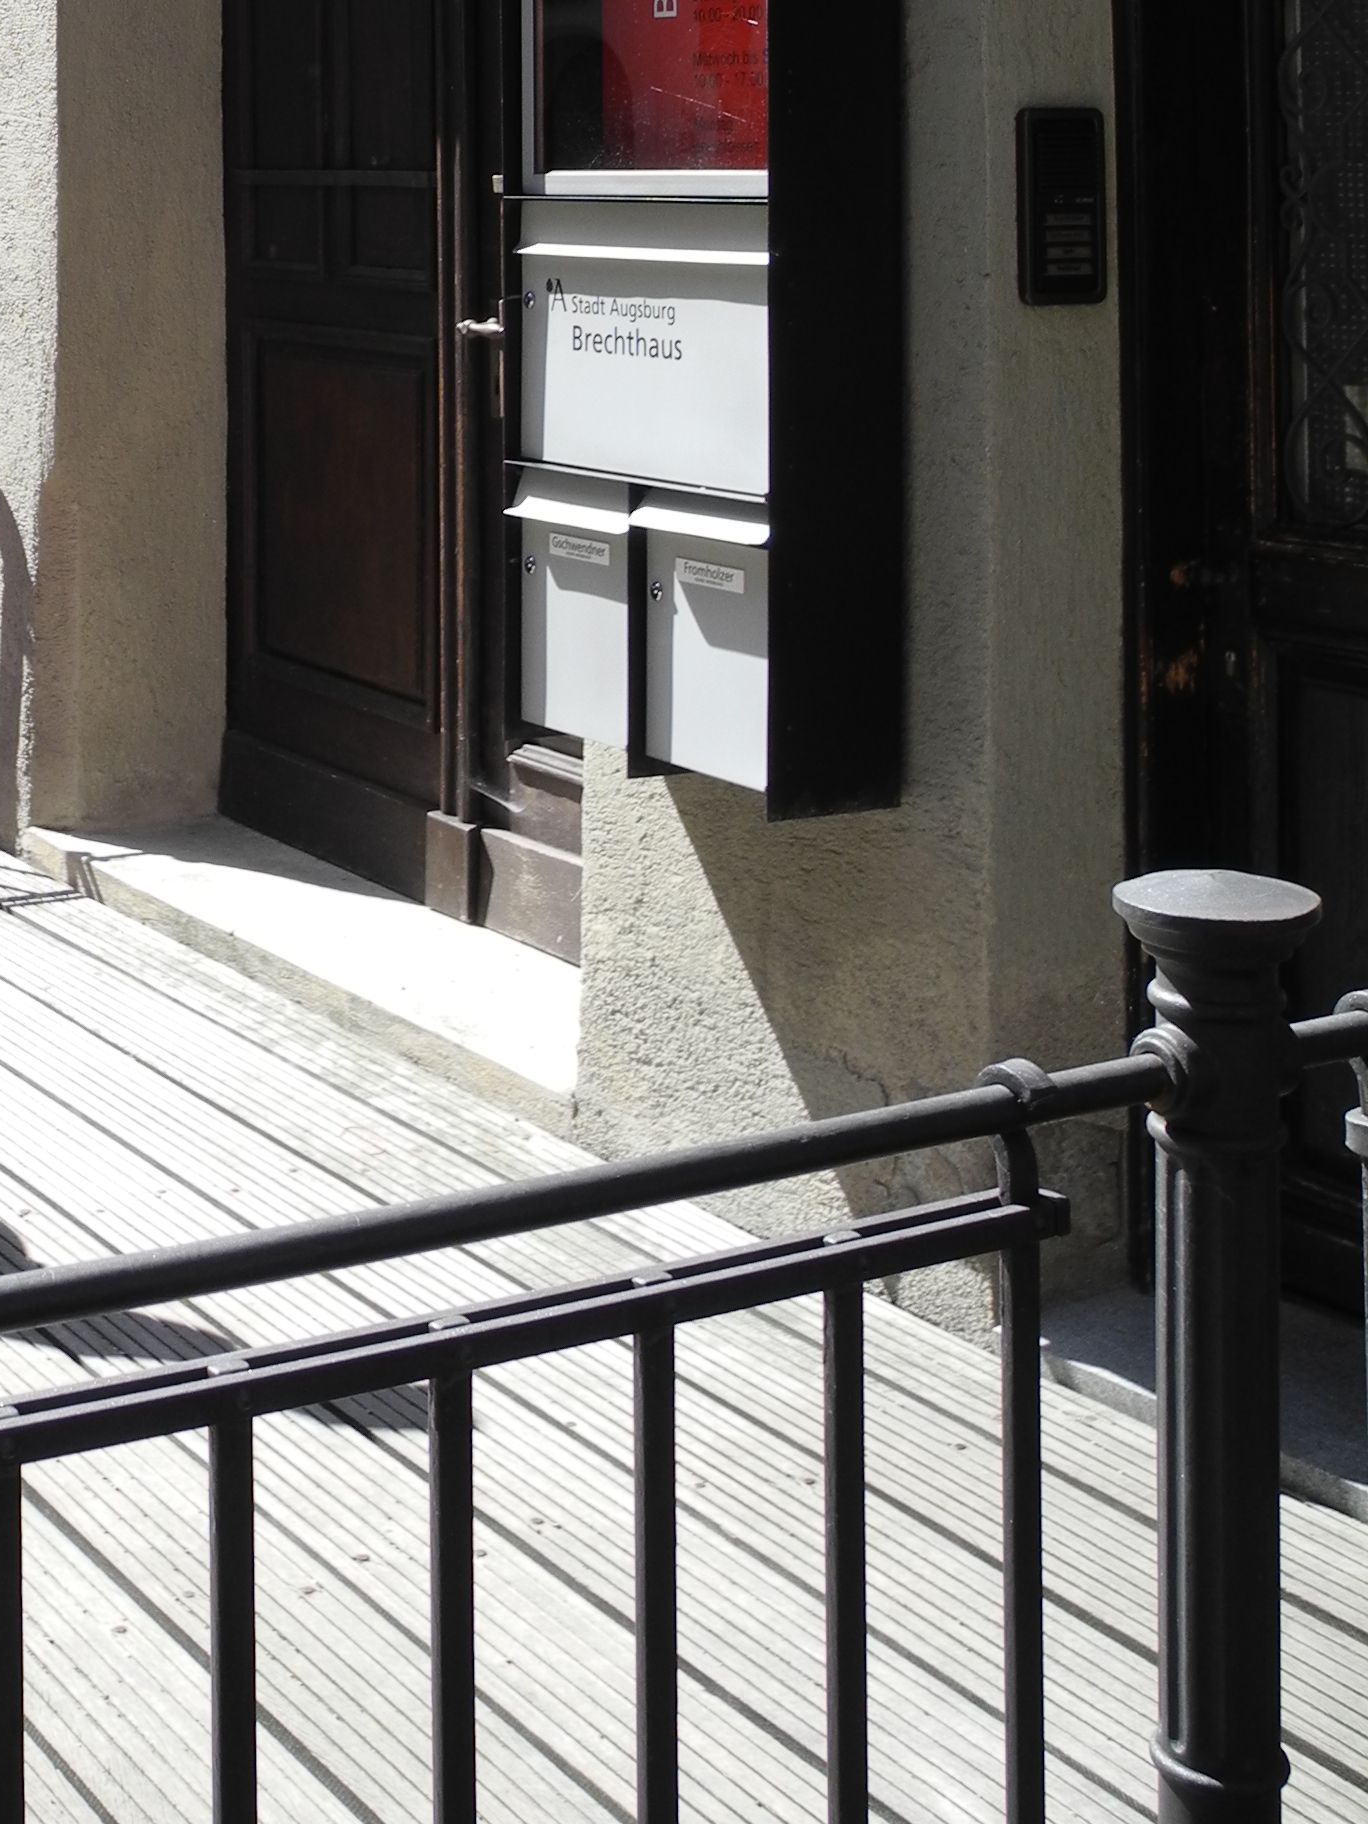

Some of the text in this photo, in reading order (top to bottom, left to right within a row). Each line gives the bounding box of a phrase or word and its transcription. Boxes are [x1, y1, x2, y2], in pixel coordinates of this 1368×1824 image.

[571, 296, 606, 316] Stadt
[609, 297, 676, 326] Augsburg
[572, 325, 683, 361] Brechthaus
